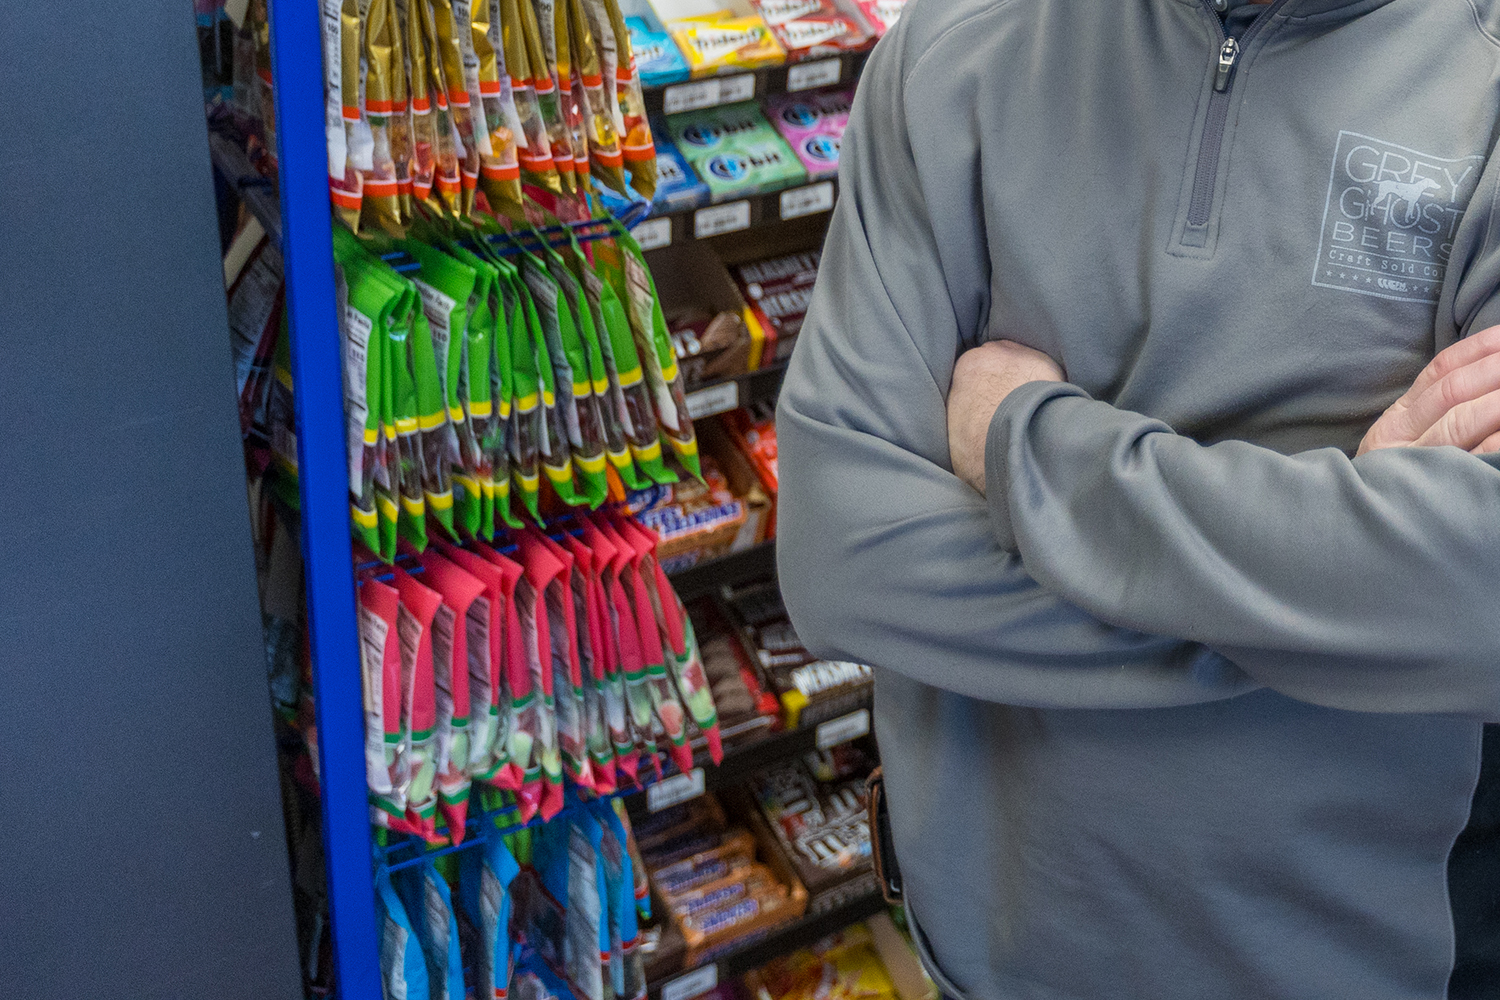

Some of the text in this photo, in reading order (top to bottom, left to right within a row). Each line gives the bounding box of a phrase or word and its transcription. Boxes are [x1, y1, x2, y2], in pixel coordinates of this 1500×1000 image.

[693, 27, 763, 50] Trident
[778, 19, 848, 40] Trident
[683, 120, 755, 148] Orbit
[709, 152, 781, 181] Orbit
[1344, 145, 1474, 204] GREY
[1339, 186, 1466, 239] GHOST
[1329, 249, 1371, 267] Craft
[1381, 259, 1415, 274] Sold
